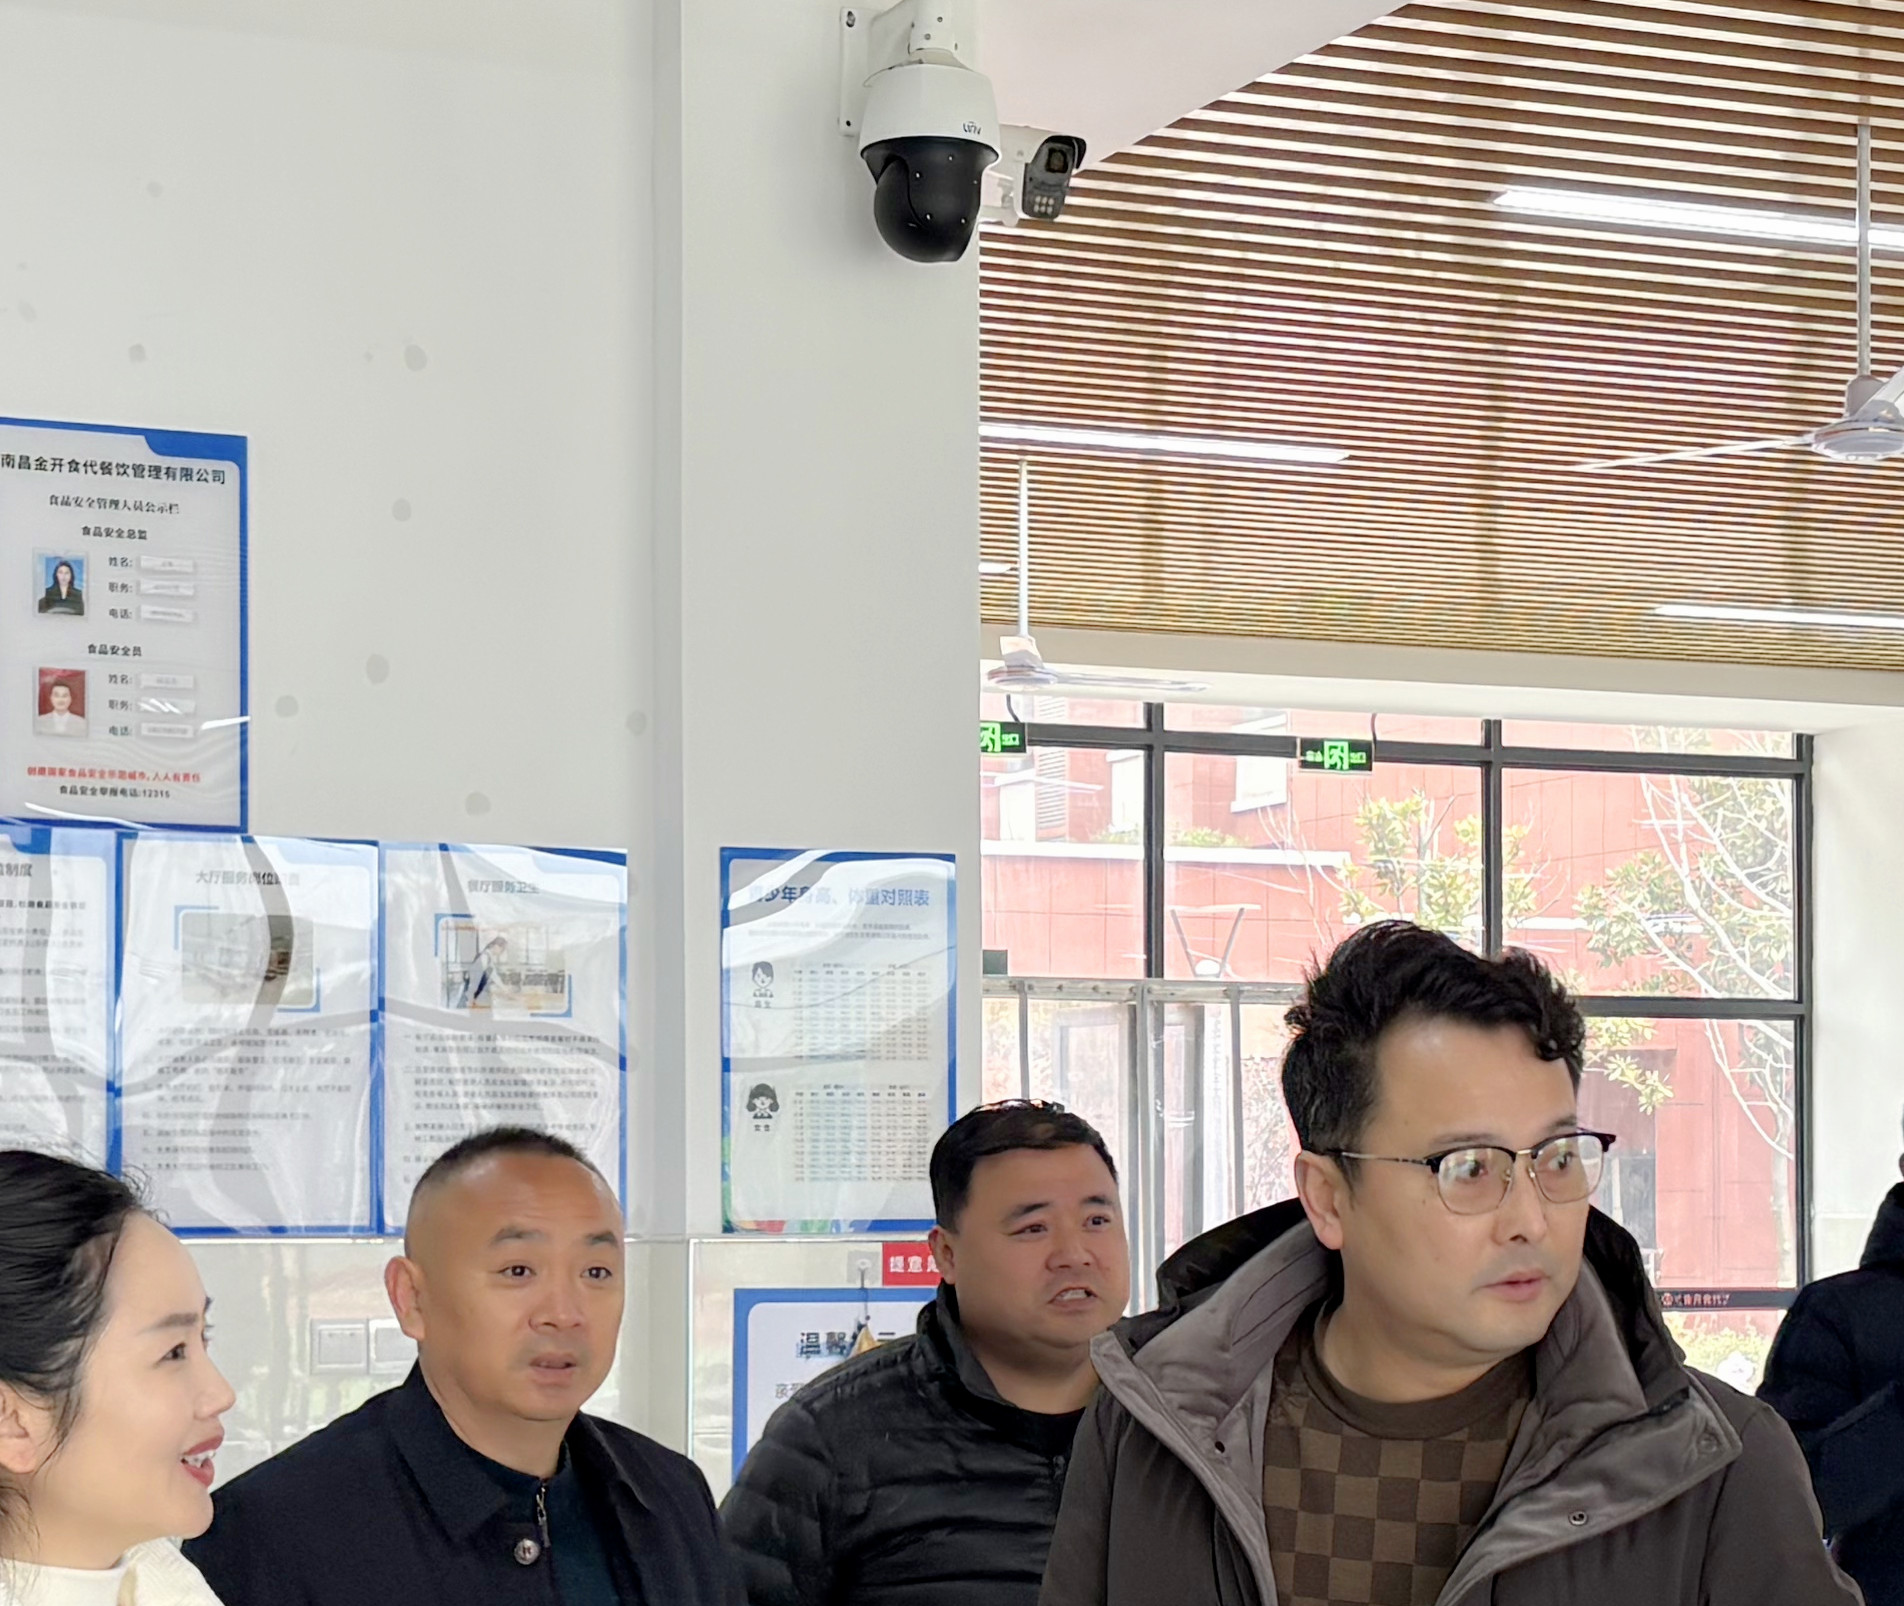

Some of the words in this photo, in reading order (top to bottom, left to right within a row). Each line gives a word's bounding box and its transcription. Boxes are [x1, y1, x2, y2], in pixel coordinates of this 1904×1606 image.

[0, 453, 226, 485] 南昌金开食代餐饮管理有限公司
[48, 494, 180, 515] 食品安全管理人员公示栏
[81, 525, 148, 541] 食品安全总监
[87, 643, 143, 657] 食品安全员
